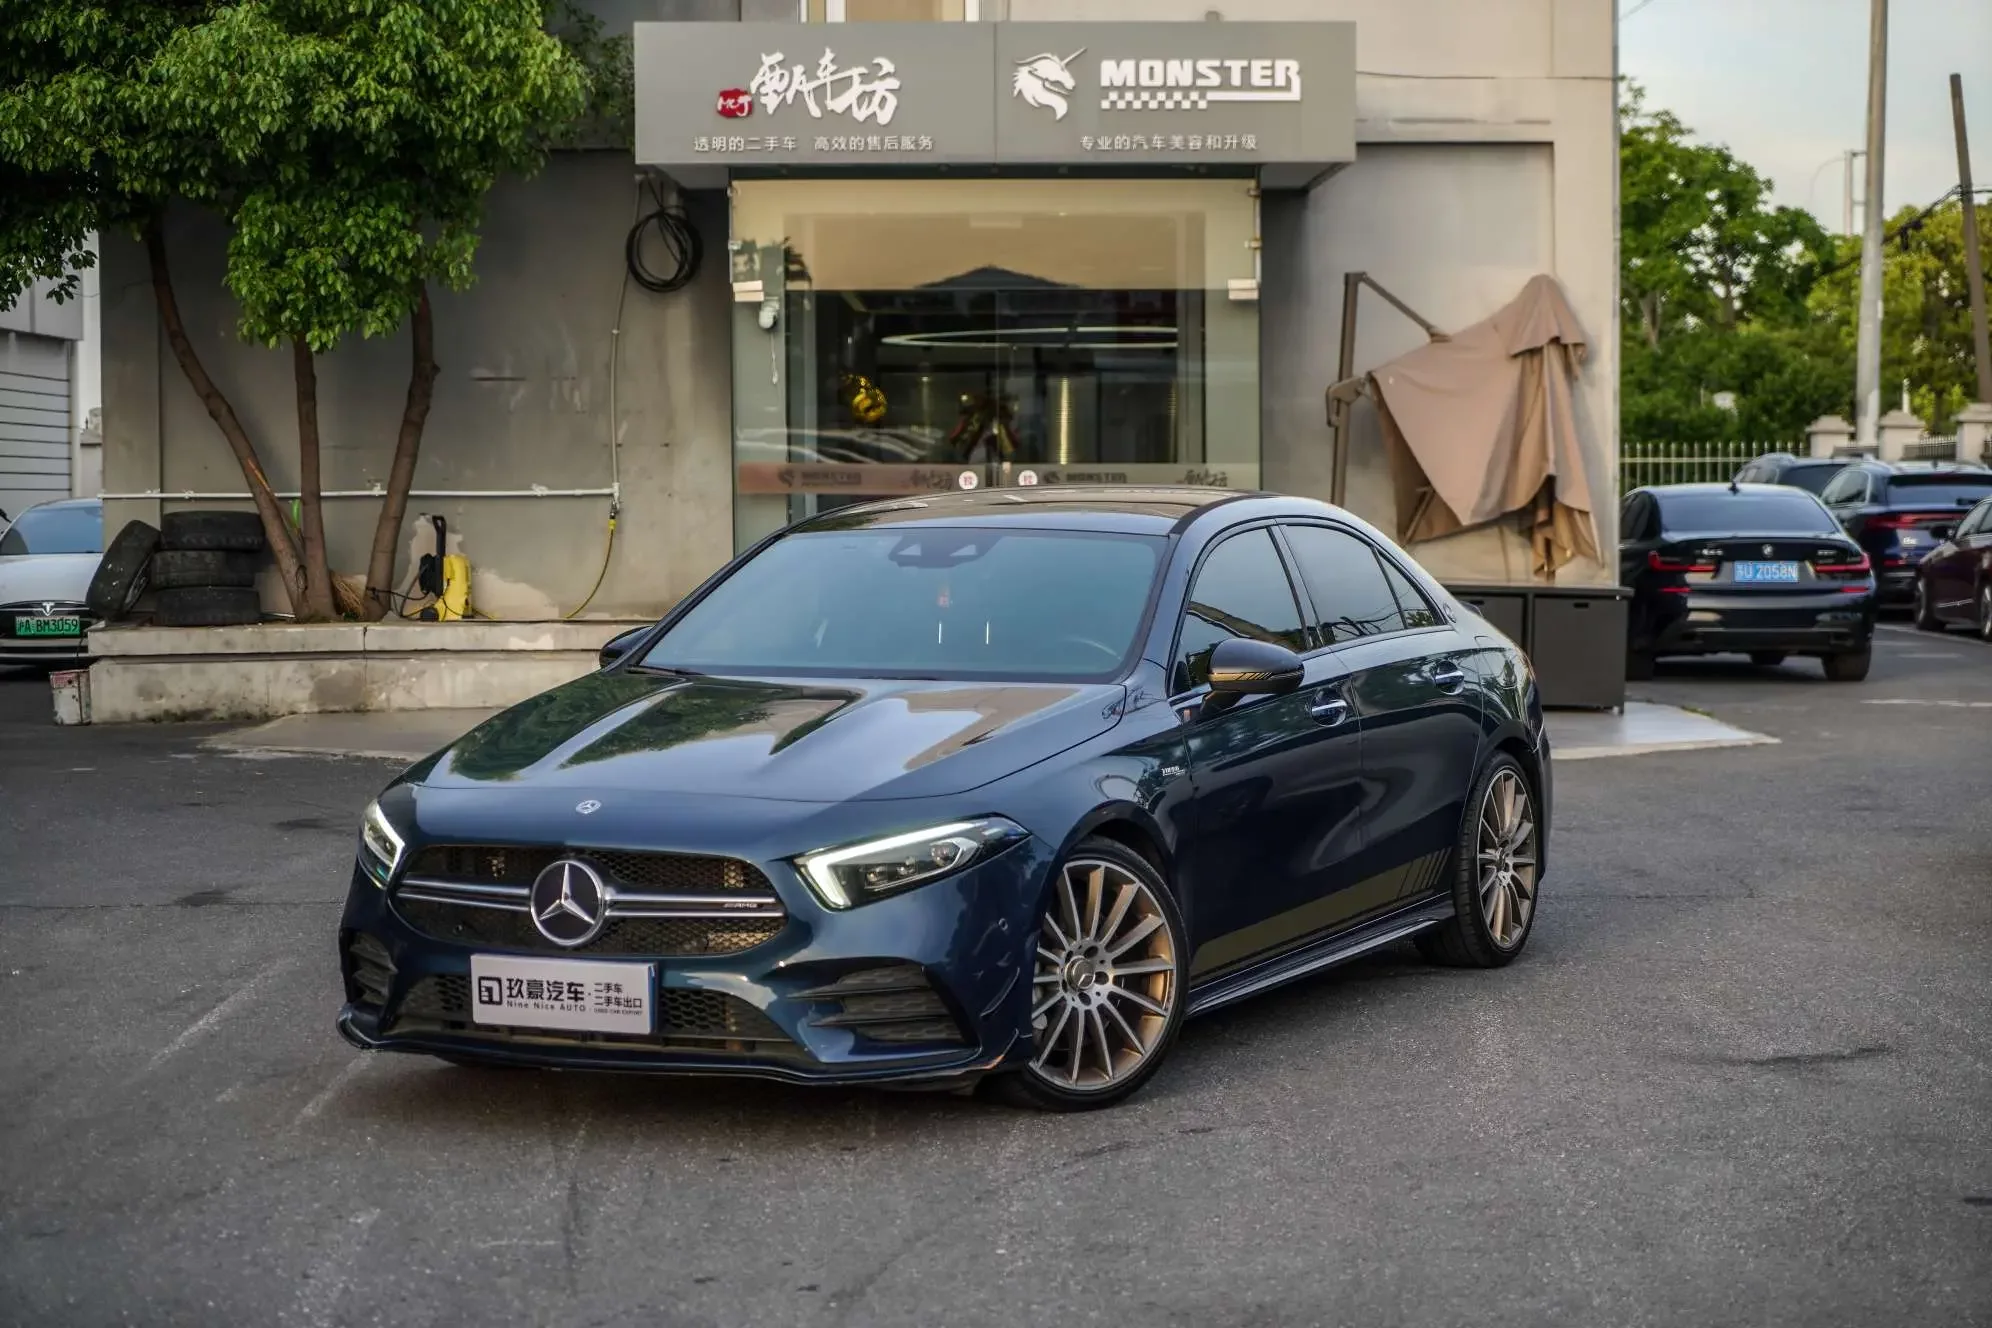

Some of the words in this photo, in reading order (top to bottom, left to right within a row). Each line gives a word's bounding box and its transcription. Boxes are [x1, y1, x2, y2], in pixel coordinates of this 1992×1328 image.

[1101, 59, 1301, 101] MONSTER
[694, 136, 798, 152] 透明的二手车
[814, 135, 935, 152] 高效的售后服务
[1080, 134, 1259, 150] 专业的汽车美容和升级
[506, 978, 585, 1002] 玖豪汽车
[594, 982, 623, 993] 二手车
[507, 1001, 529, 1009] Nine
[533, 1002, 555, 1011] Nice
[560, 1003, 586, 1012] AUTO
[594, 996, 643, 1009] 二手车出口
